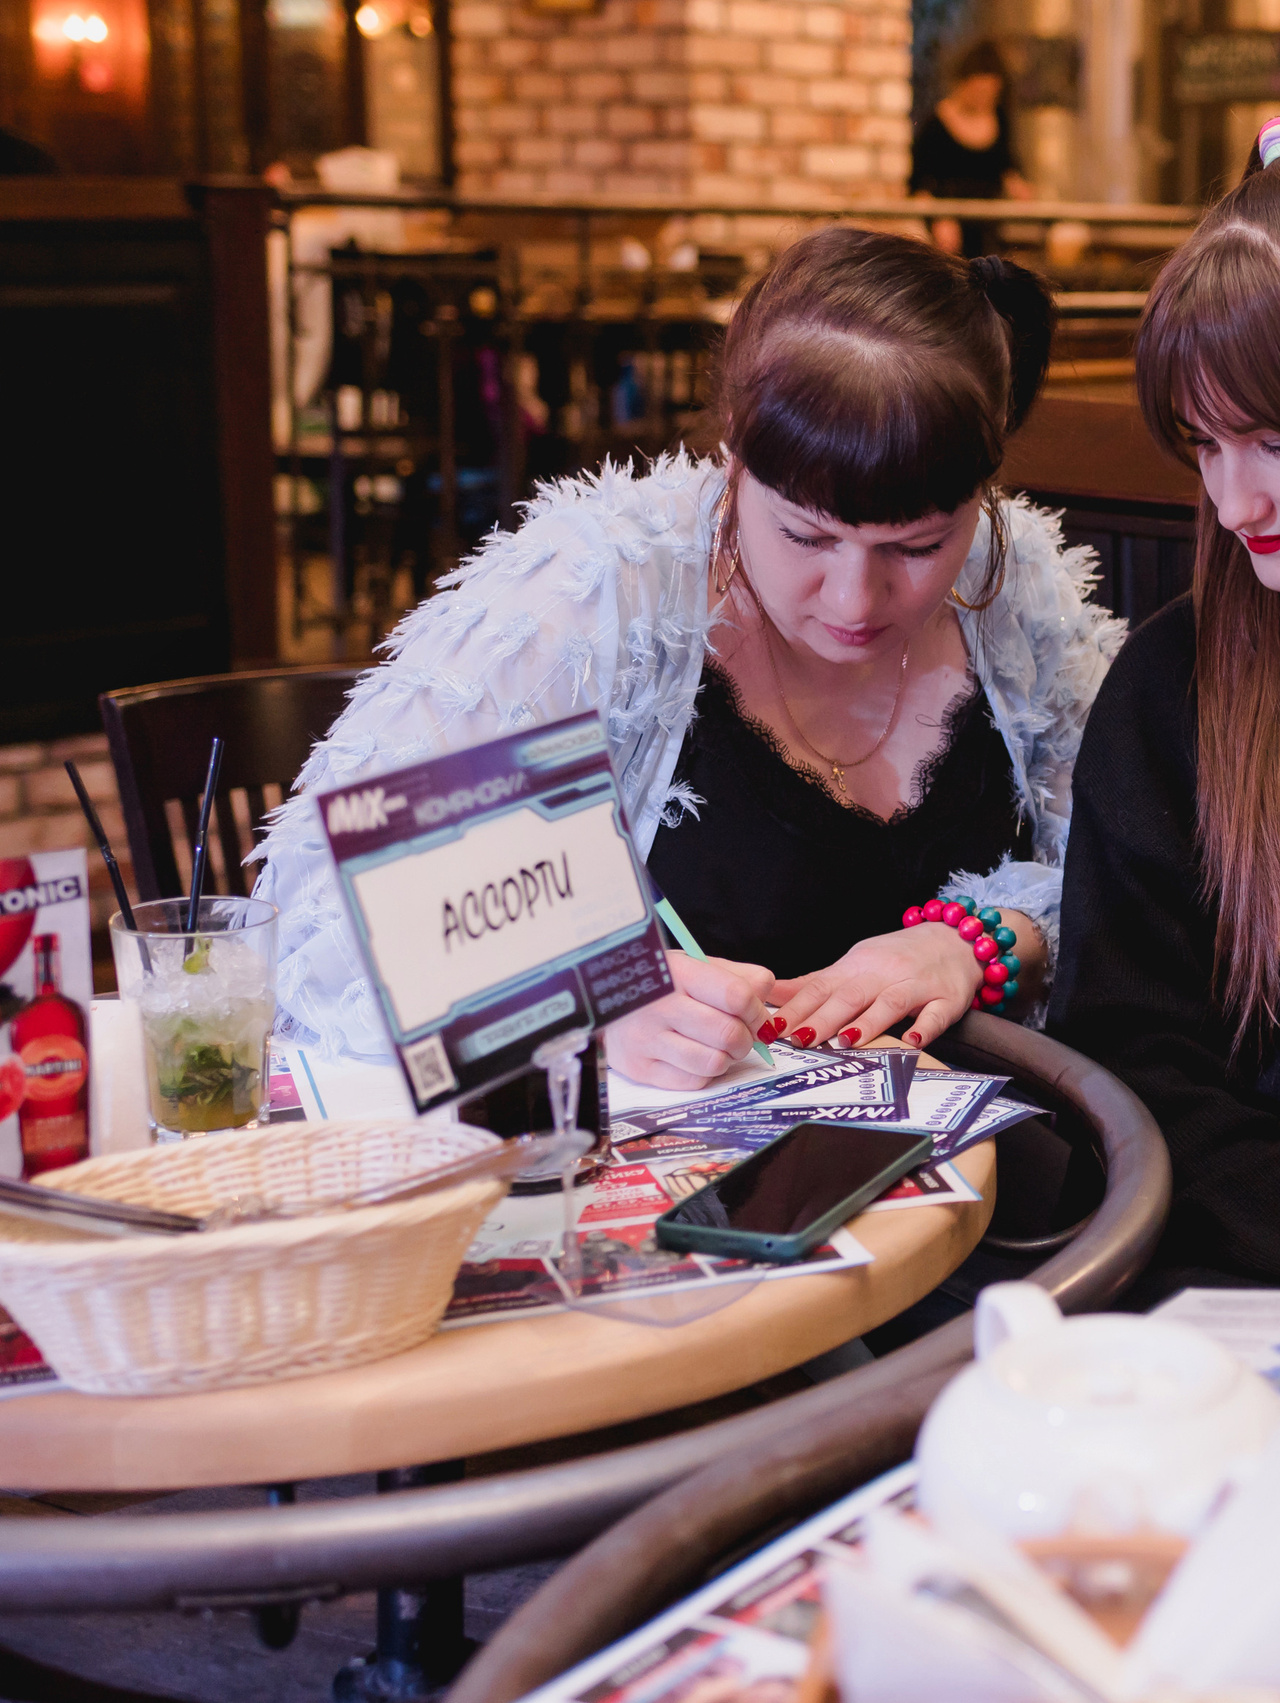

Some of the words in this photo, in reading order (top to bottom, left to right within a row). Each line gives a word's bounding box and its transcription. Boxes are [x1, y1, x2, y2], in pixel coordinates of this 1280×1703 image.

[0, 879, 79, 913] ONIC
[443, 851, 574, 954] АССОРТИ
[656, 1144, 708, 1155] КРАСКИ
